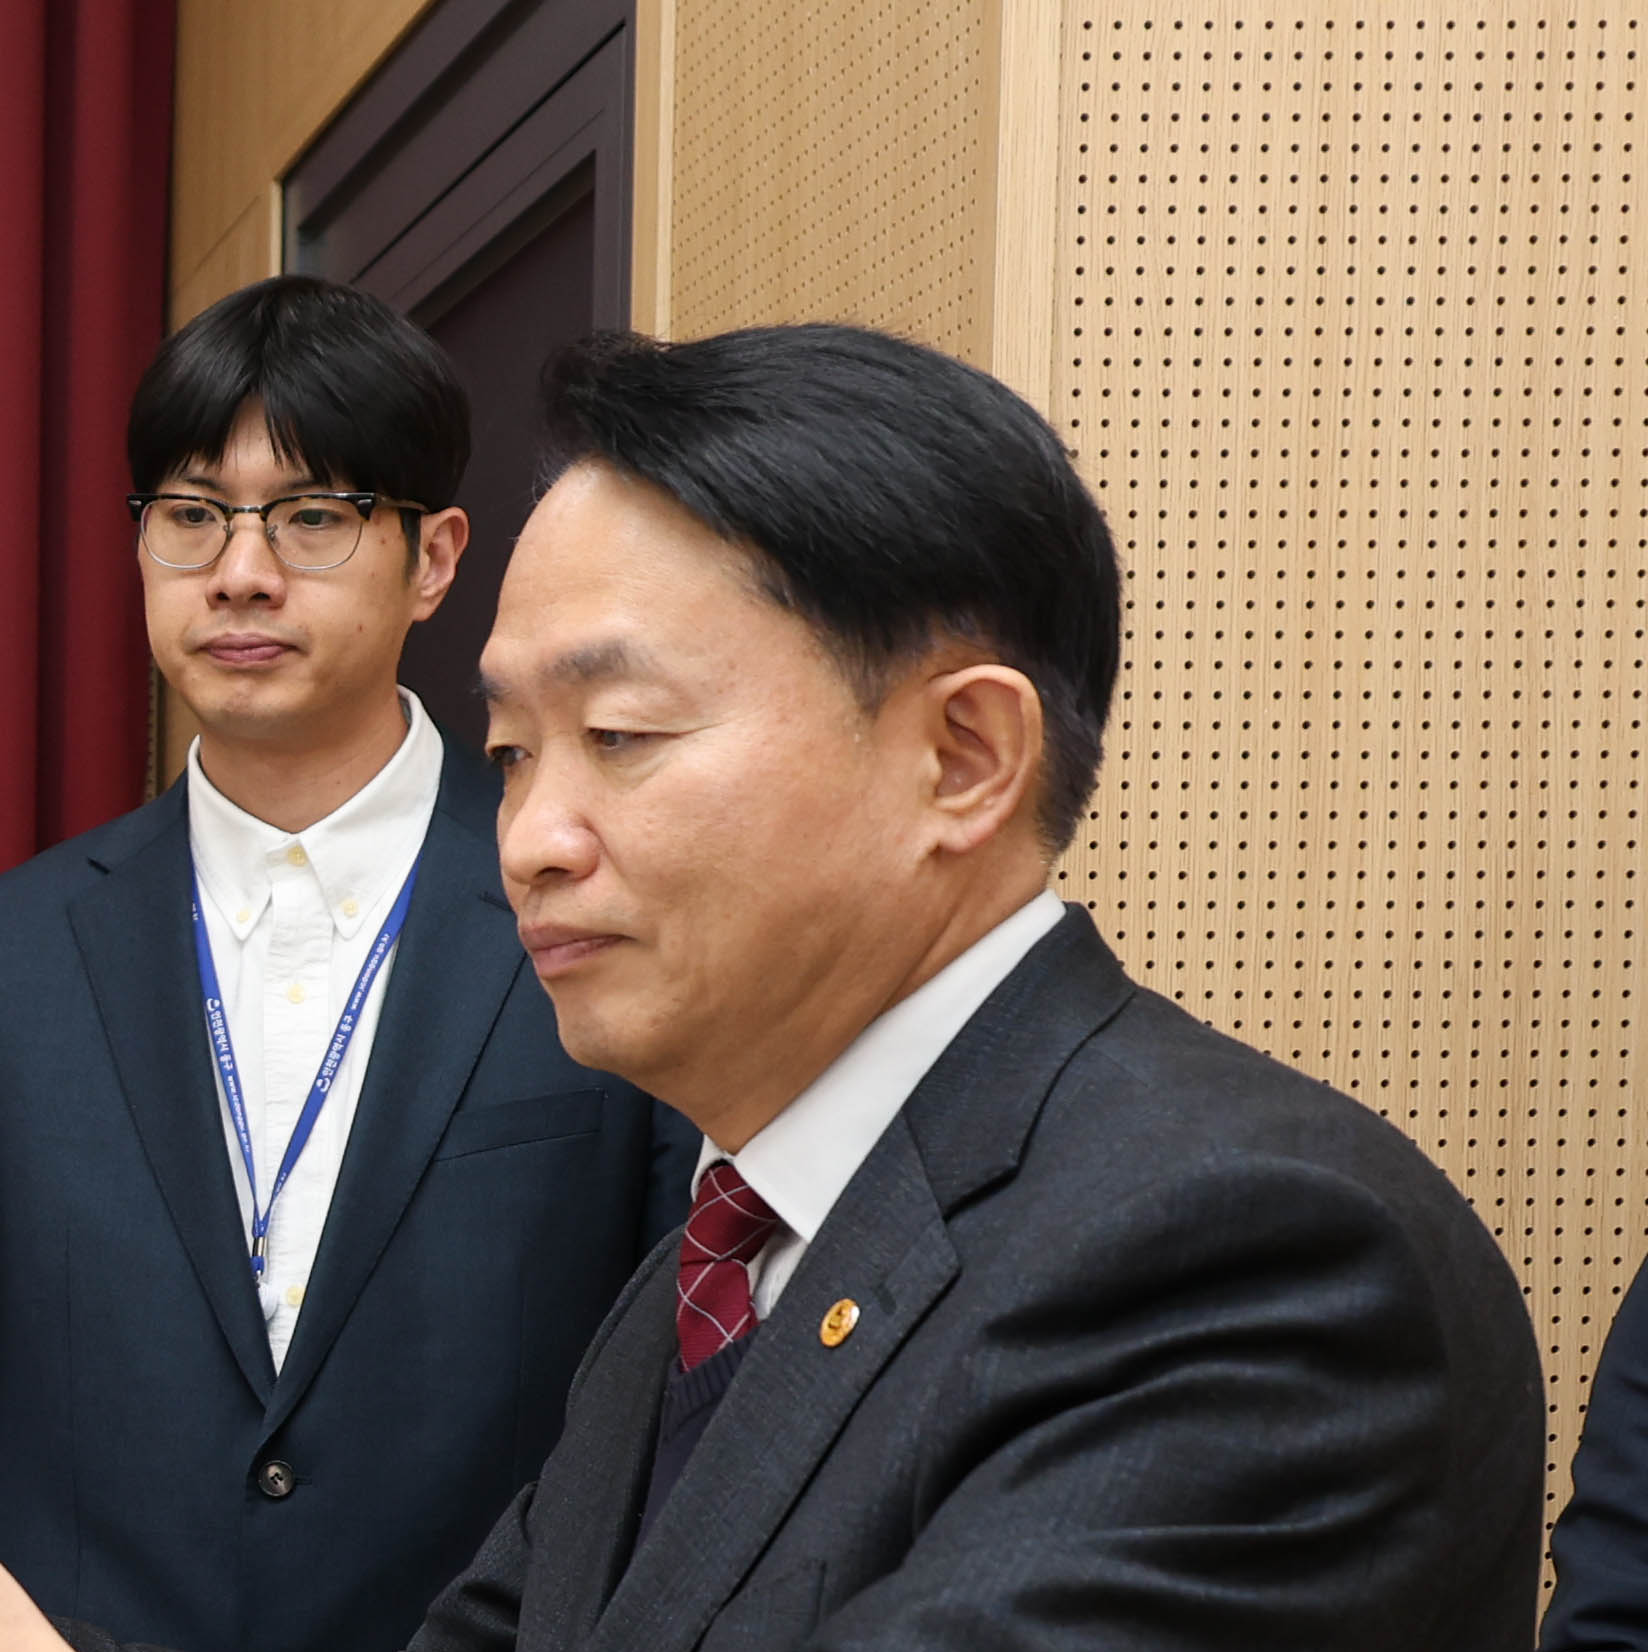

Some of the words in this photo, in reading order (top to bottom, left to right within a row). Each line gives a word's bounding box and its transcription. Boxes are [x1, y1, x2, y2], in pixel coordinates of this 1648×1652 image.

[211, 1011, 229, 1051] 인천광역시
[220, 1054, 233, 1070] 동구
[322, 1034, 345, 1076] 인천광역시
[340, 1015, 353, 1032] 동구
